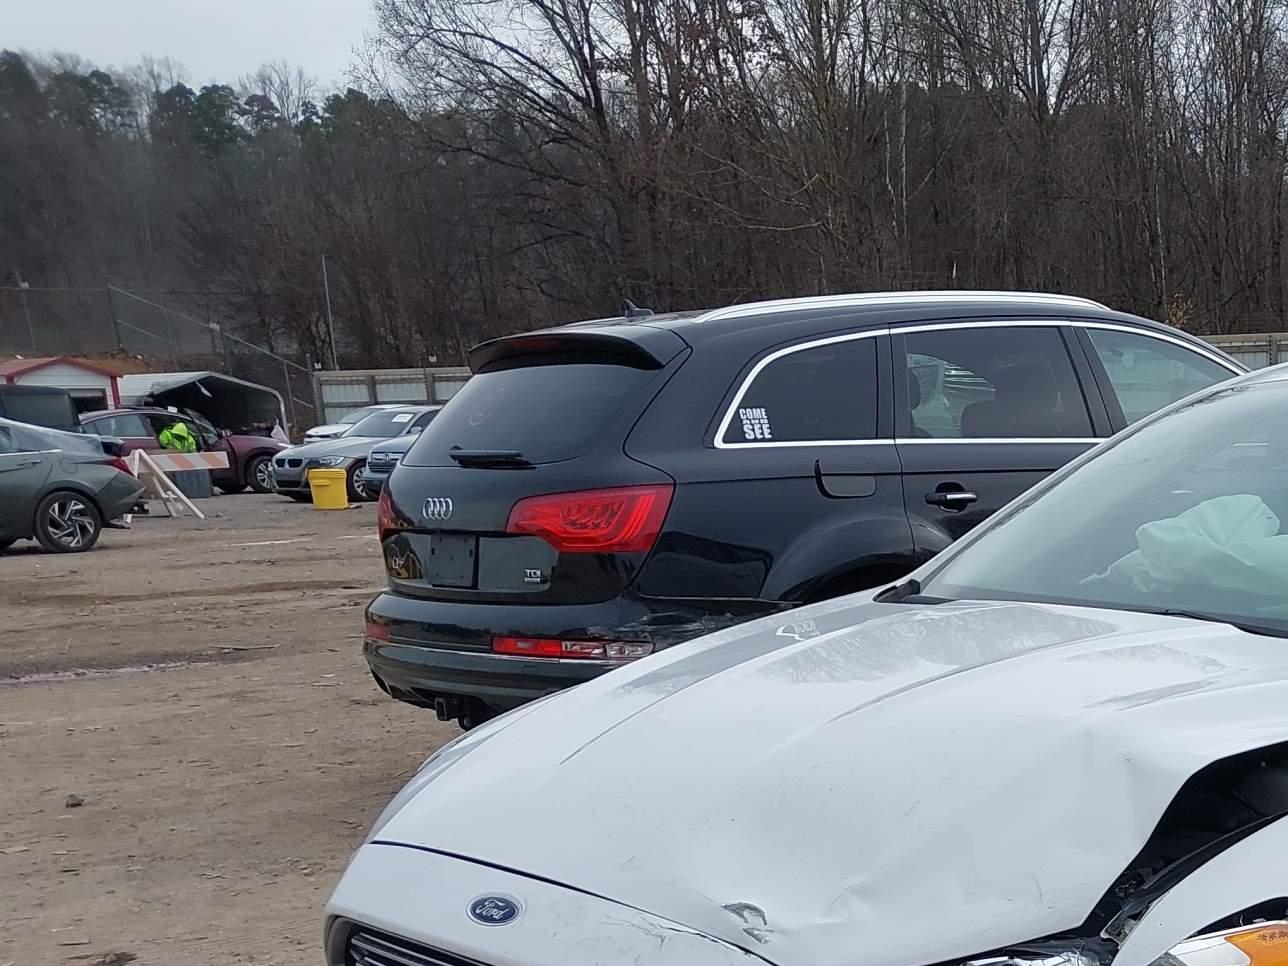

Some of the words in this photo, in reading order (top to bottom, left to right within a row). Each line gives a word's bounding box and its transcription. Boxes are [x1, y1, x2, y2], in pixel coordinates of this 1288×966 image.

[739, 408, 768, 419] COME
[743, 424, 772, 439] SEE
[524, 569, 541, 578] TDI
[474, 899, 510, 919] Ford
